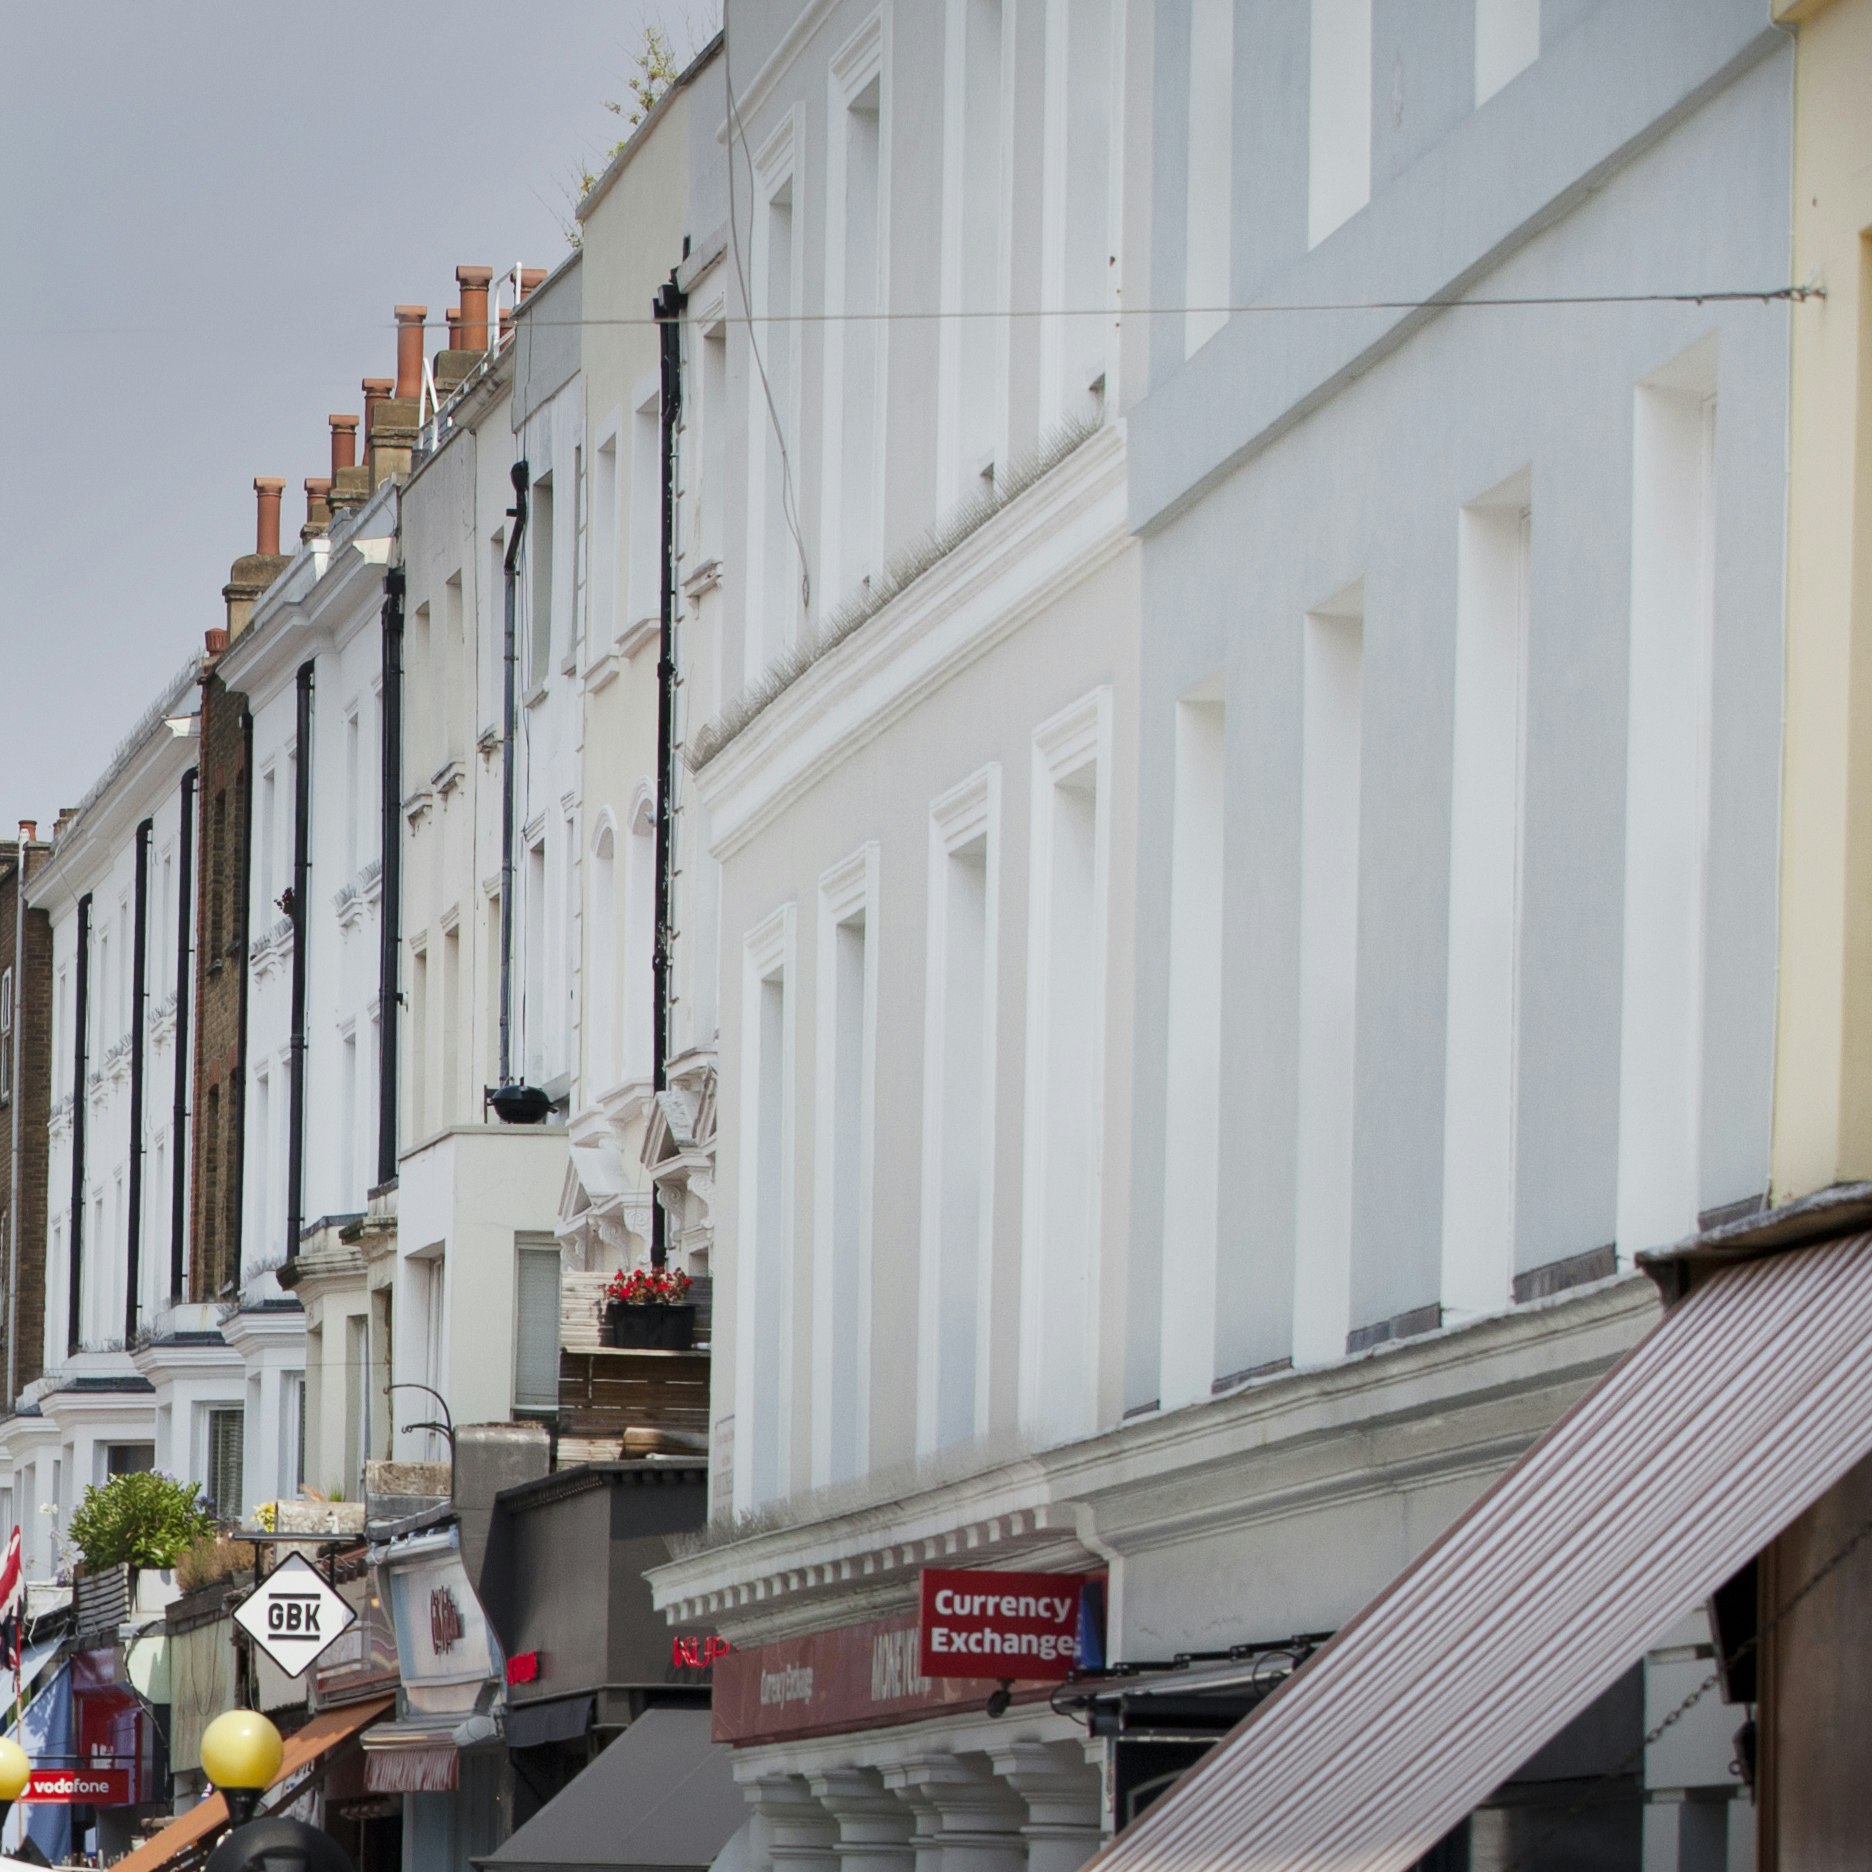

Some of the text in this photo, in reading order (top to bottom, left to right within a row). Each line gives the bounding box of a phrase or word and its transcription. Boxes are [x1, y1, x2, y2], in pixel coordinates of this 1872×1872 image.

[268, 1602, 322, 1632] GBK
[934, 1589, 1072, 1623] Currency
[931, 1627, 1076, 1660] Exchange
[34, 1778, 109, 1793] vodafone
